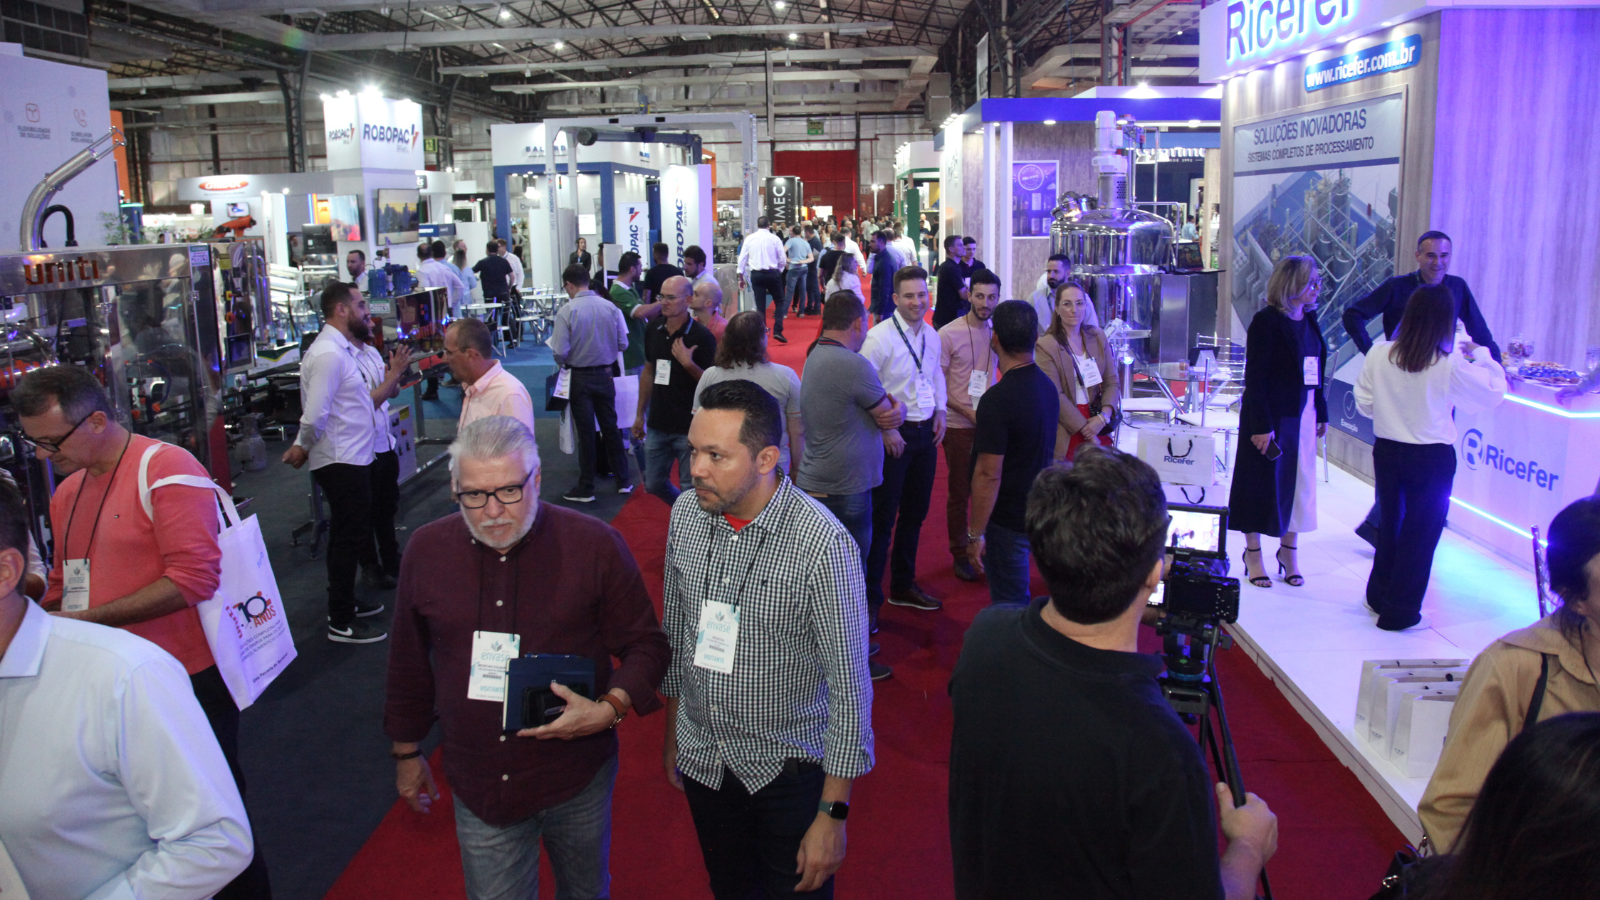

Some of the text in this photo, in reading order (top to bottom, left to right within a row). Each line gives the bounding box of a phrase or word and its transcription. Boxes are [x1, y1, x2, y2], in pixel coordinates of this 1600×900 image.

[1306, 43, 1415, 87] www.ricefer.com.br
[329, 127, 350, 140] ROBOPAC
[363, 123, 409, 143] ROBOPAC
[1254, 109, 1367, 146] SOLUÇÕES INOVADORAS
[525, 145, 566, 153] BALRD
[1248, 136, 1374, 163] SISTEMAS COMPLETOS DE PROCESSAMENTO
[773, 186, 786, 223] IMEC
[629, 224, 640, 255] OPAC
[676, 198, 685, 269] OBOPAC
[1164, 455, 1195, 466] Ricefer
[1485, 444, 1559, 491] Ricefer
[253, 605, 277, 628] ANOS
[707, 620, 731, 634] envase
[481, 651, 511, 662] envase
[704, 653, 725, 665] VISITANTE
